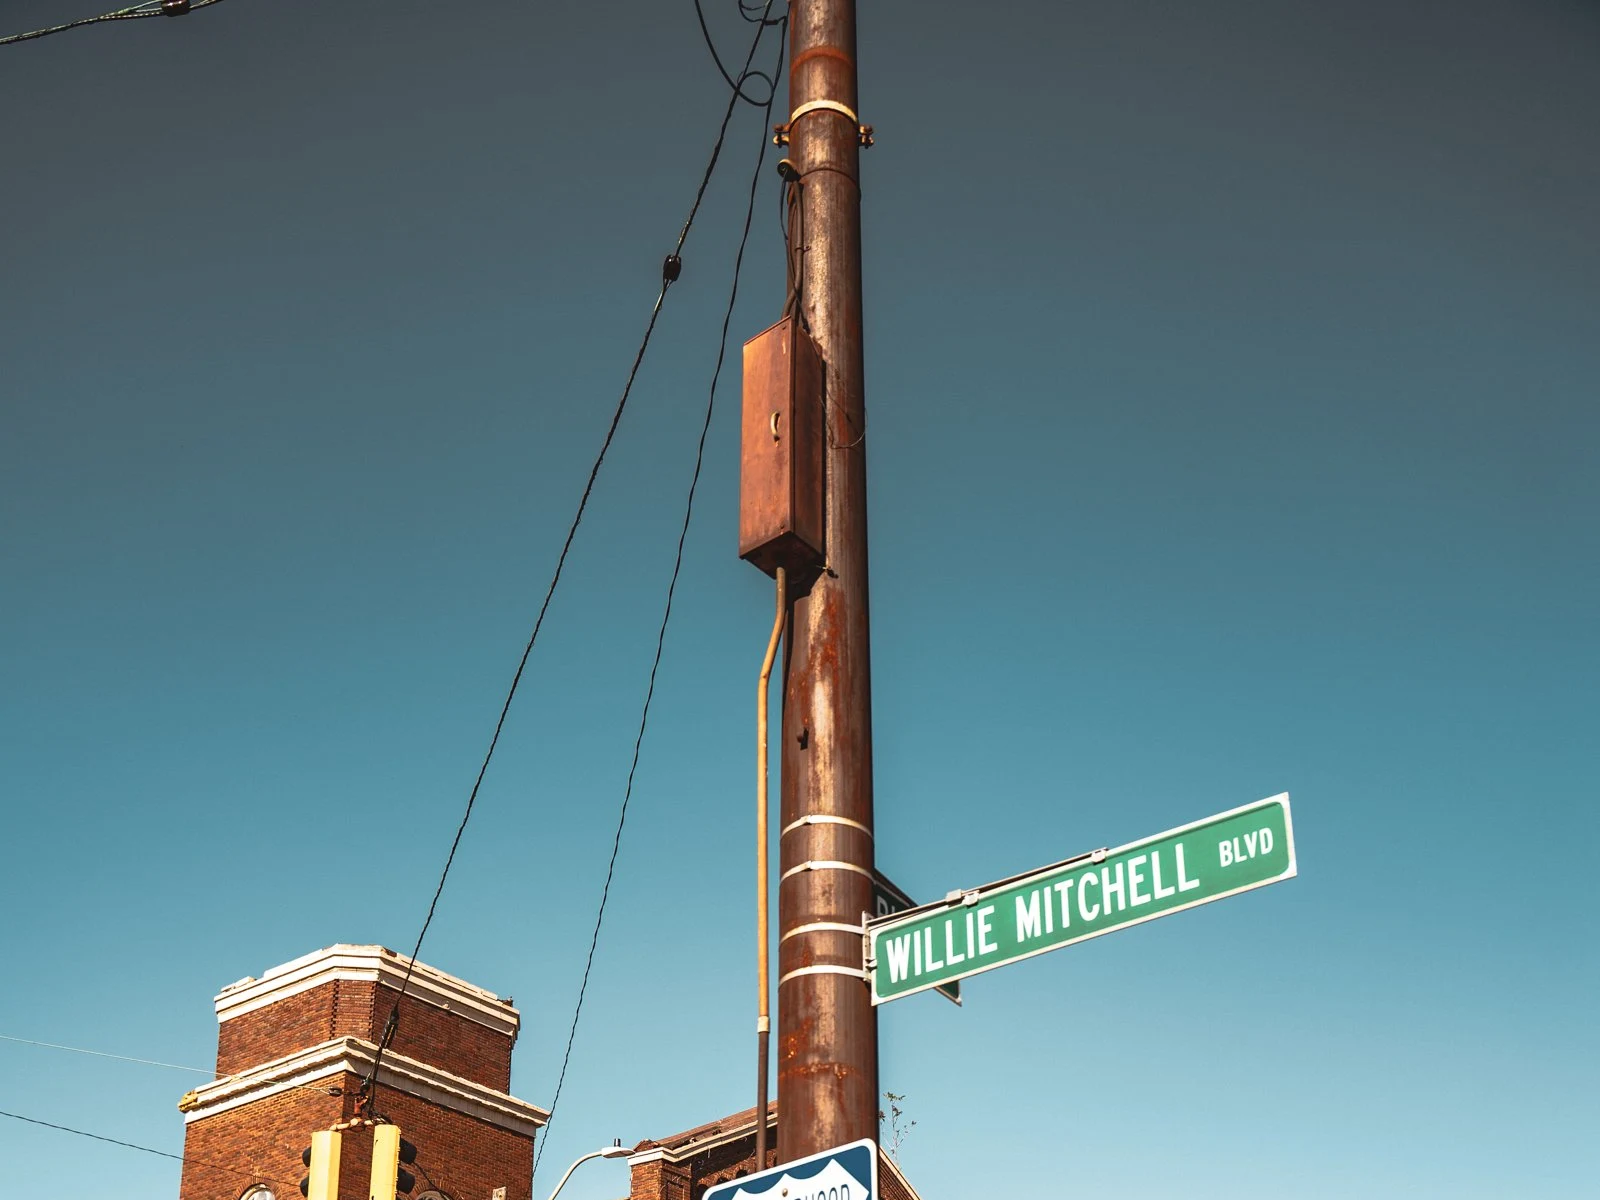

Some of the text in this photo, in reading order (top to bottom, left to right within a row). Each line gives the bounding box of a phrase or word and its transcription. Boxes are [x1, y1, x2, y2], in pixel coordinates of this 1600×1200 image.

[885, 827, 1275, 984] WILLIE MITCHELL BLVD
